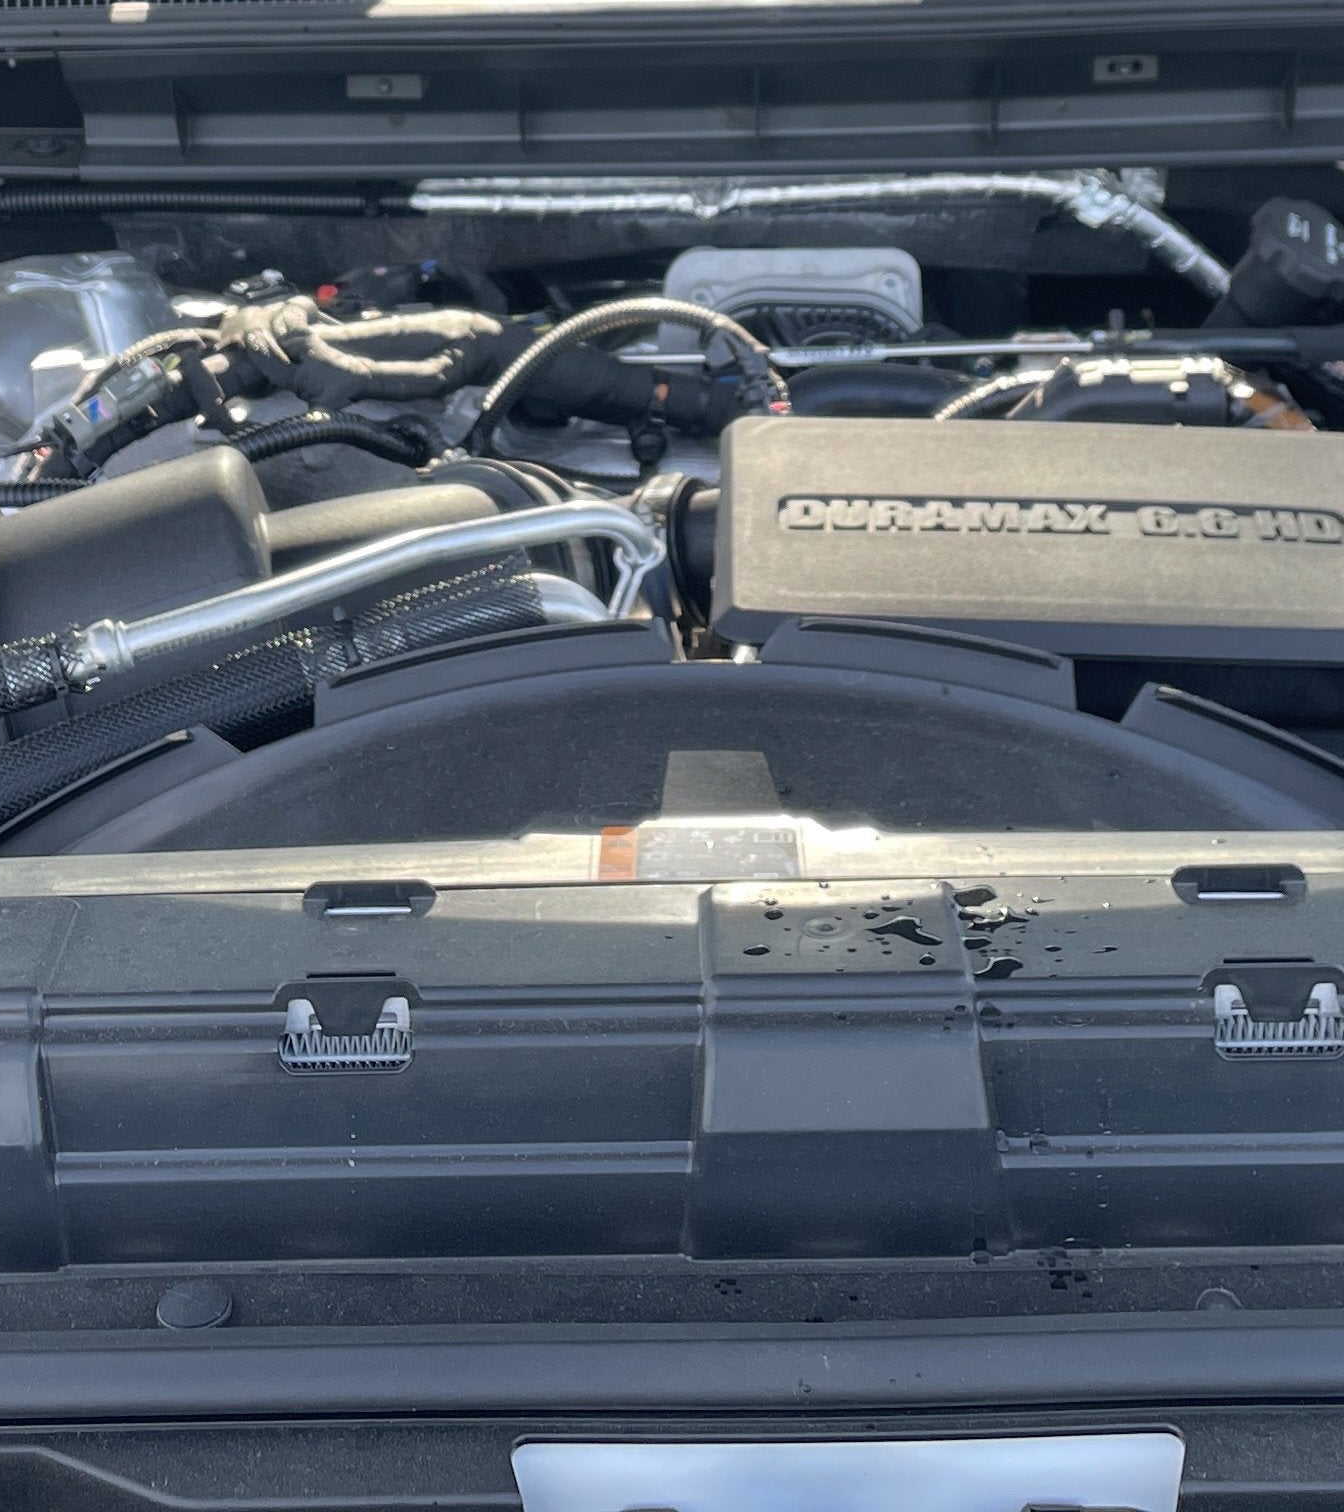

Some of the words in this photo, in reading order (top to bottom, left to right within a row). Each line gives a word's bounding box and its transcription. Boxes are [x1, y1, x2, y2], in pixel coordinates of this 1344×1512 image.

[782, 498, 1109, 534] DURAMAX
[1137, 505, 1240, 538] 6.6
[1256, 509, 1344, 544] HD
